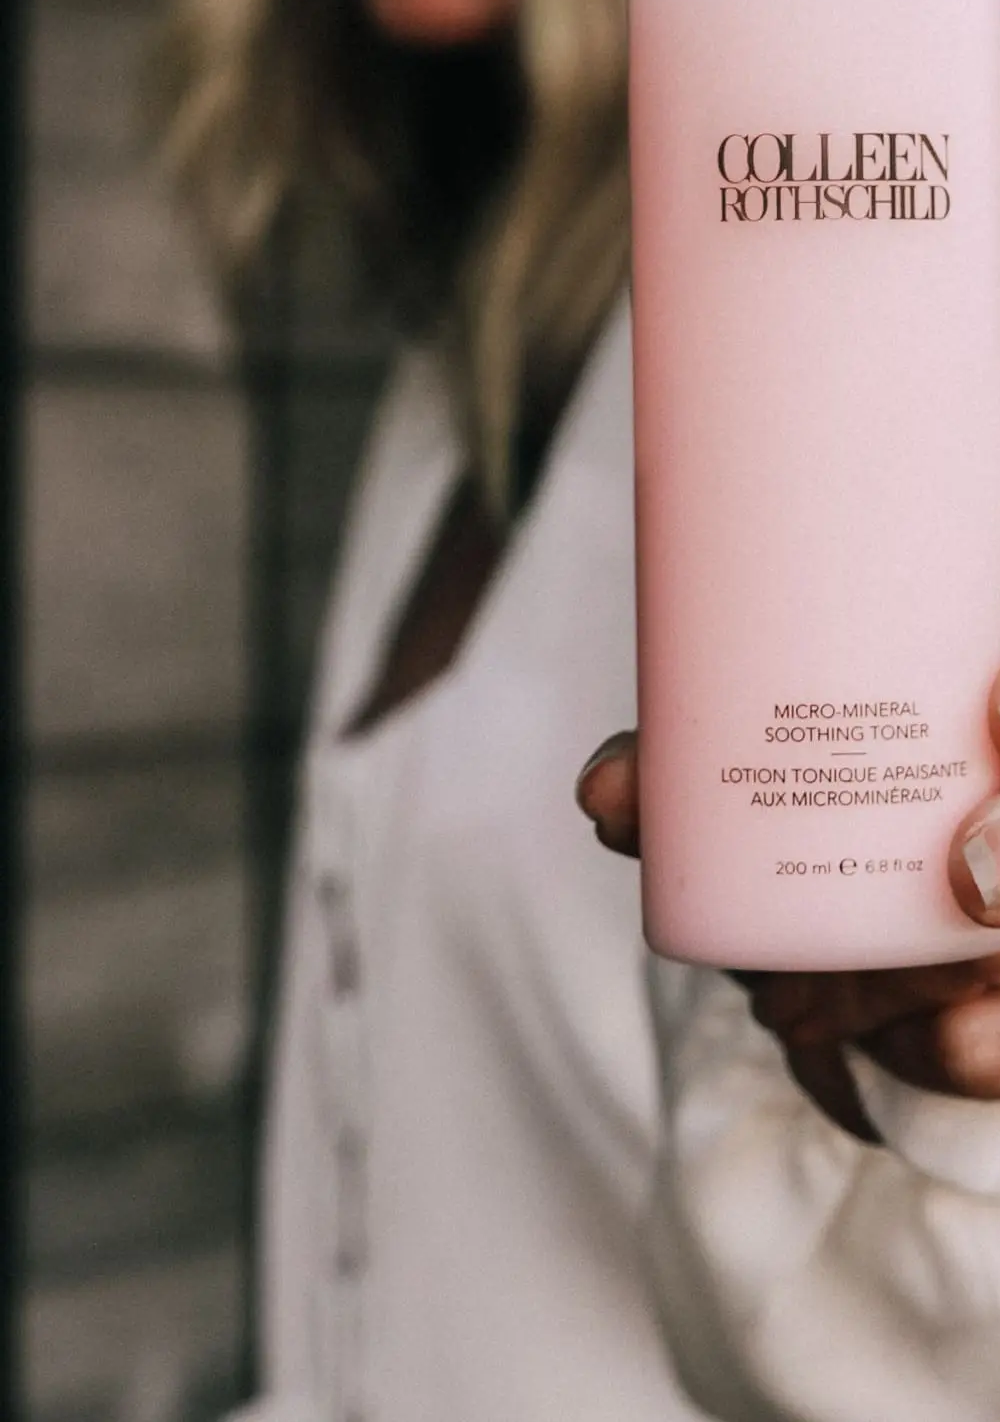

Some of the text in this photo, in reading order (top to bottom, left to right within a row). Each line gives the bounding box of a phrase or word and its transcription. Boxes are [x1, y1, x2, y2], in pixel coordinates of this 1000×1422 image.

[717, 132, 949, 184] COLLEEN
[719, 184, 951, 222] ROTHSCHILD
[774, 701, 920, 719] MICRO-MINERAL
[764, 723, 929, 743] SOOTHING TONER
[720, 760, 968, 784] LOTION TONIQUE APAISANTE
[750, 786, 943, 807] AUX MICROMINÉRAUX
[775, 862, 807, 876] 200
[812, 861, 831, 875] ml
[893, 859, 902, 873] fl
[907, 859, 924, 872] oz
